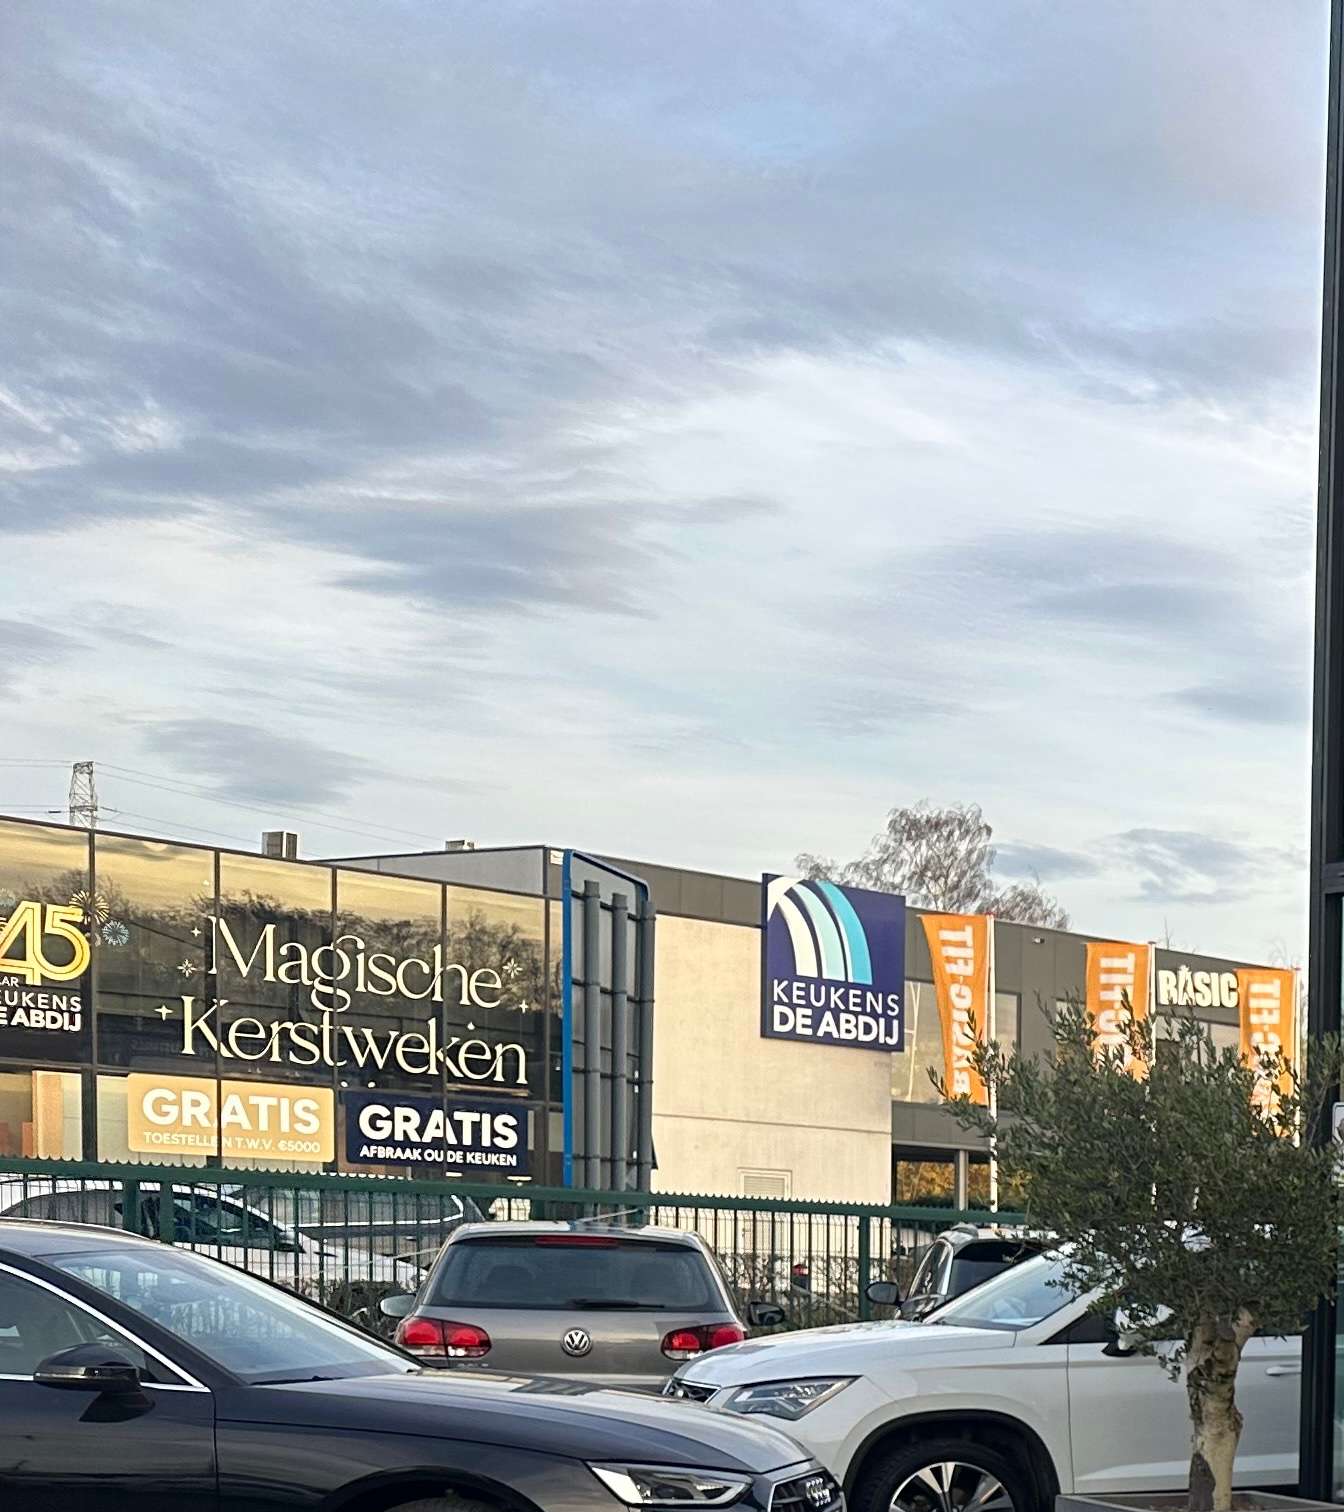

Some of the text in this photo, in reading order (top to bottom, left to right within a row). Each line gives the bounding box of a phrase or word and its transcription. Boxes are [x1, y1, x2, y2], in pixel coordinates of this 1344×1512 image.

[0, 900, 91, 986] 45
[207, 915, 503, 1013] Magische
[0, 989, 82, 1013] UKENS
[773, 979, 900, 1017] KEUKENS
[10, 1007, 82, 1032] ABDIJ
[181, 995, 529, 1085] Kerstweken
[772, 1004, 899, 1046] DE ABDIJ
[142, 1087, 321, 1135] GRATIS
[358, 1103, 519, 1149] GRATIS
[143, 1131, 233, 1149] TOESTELLEN
[277, 1139, 321, 1154] €5000
[359, 1144, 422, 1161] AFBRAAK
[466, 1151, 518, 1167] KEUKEN
